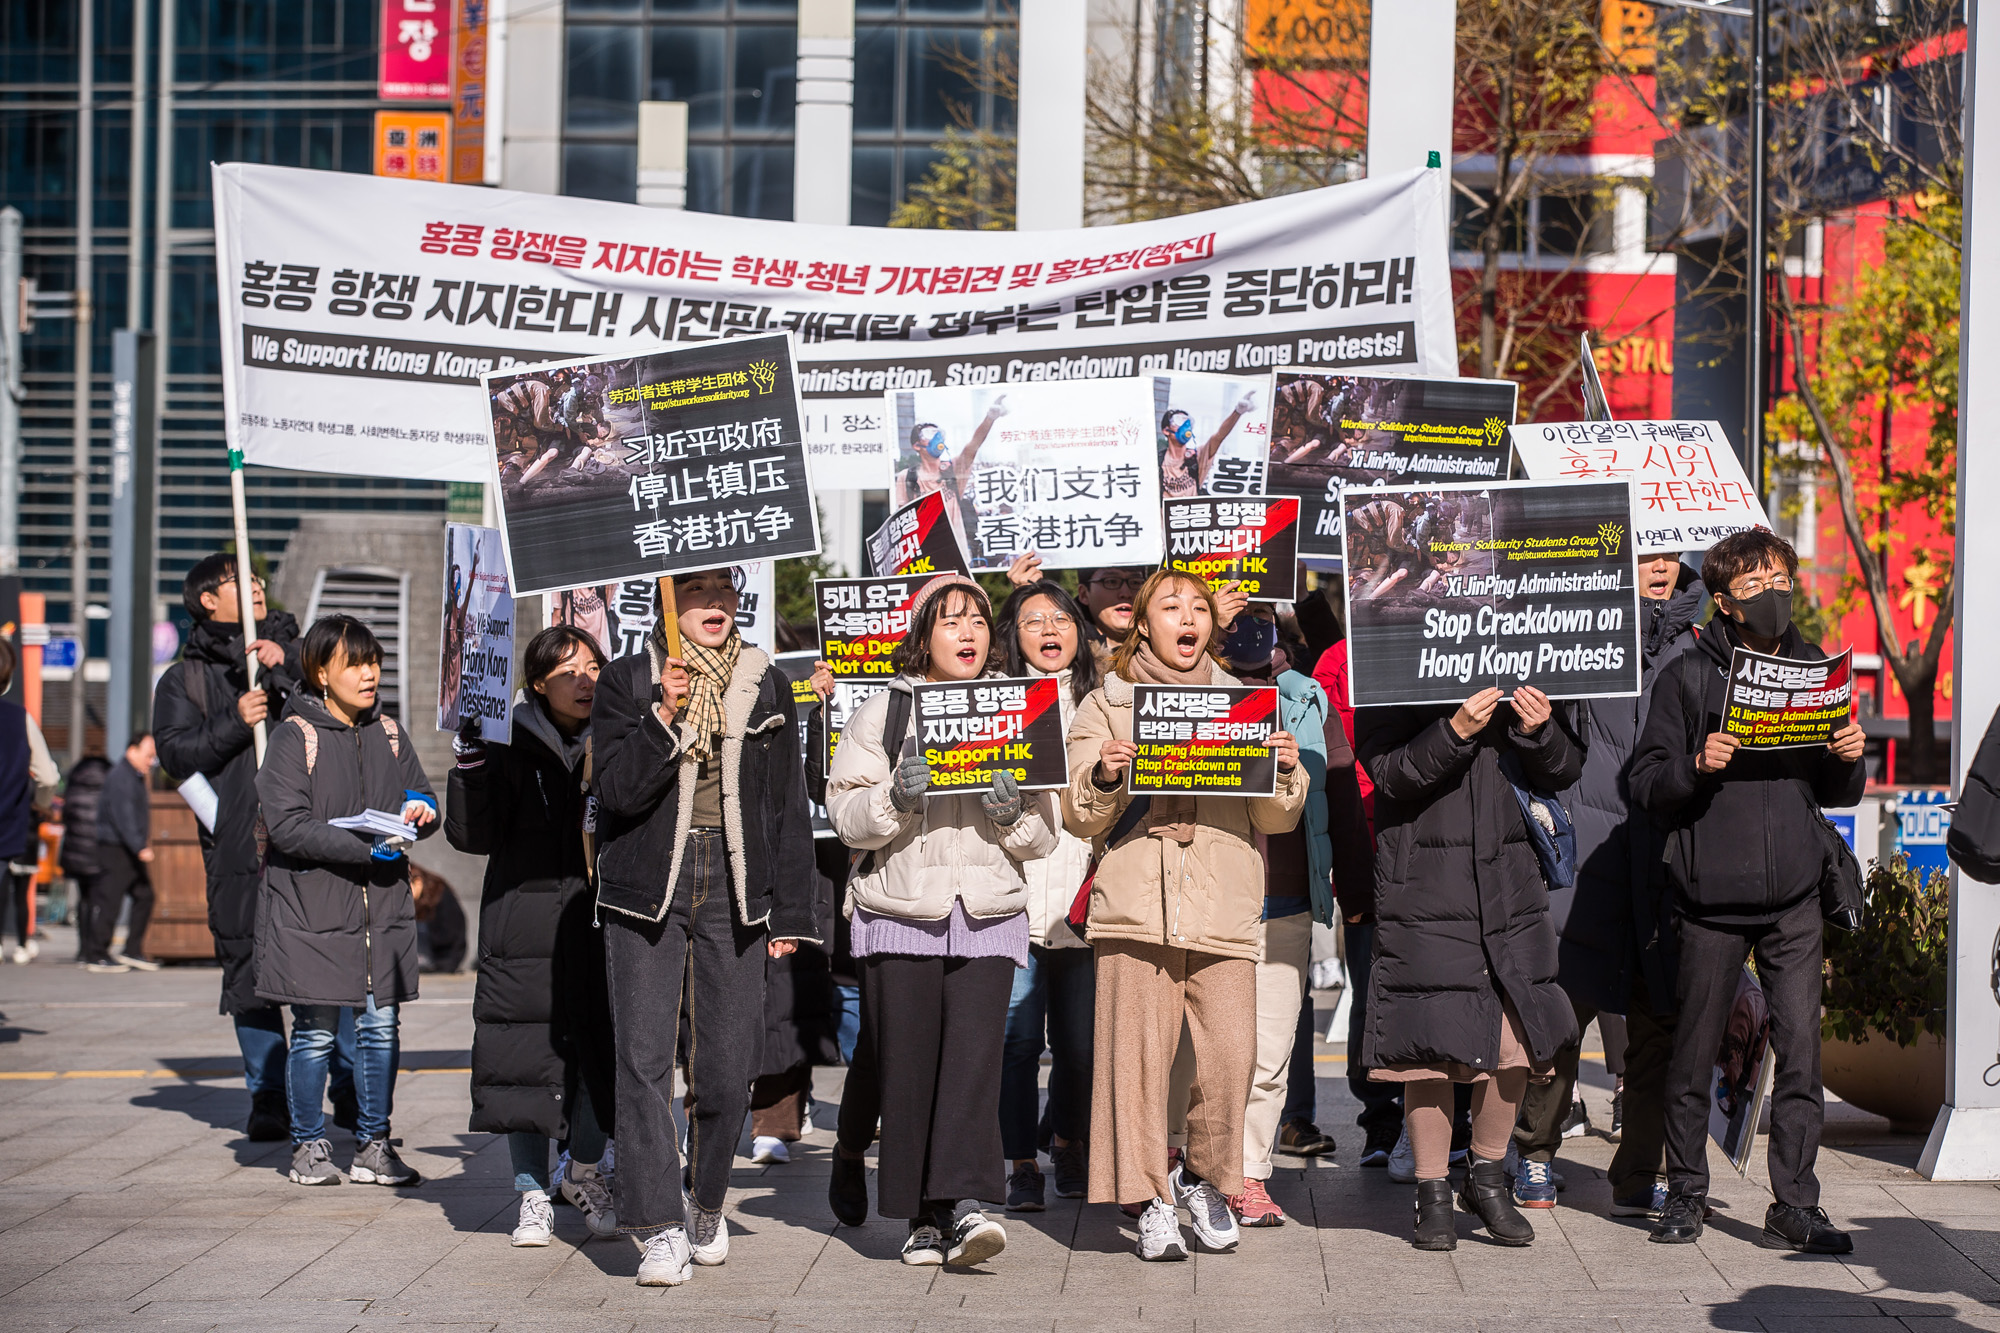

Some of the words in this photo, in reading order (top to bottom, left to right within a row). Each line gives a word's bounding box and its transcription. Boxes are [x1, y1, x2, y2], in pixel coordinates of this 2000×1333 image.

[420, 221, 485, 257] 홍콩
[490, 227, 587, 269] 항쟁을
[592, 241, 722, 281] 지지하는
[875, 265, 1005, 295] 기자회견
[1008, 262, 1043, 290] 및
[1045, 232, 1217, 285] 홍보전(행진)
[242, 260, 320, 311] 홍콩
[328, 268, 420, 320] 항쟁
[424, 279, 623, 337] 지지한다!
[1075, 273, 1211, 329] 탄압을
[1223, 256, 1415, 318] 중단하라!
[251, 333, 279, 362] We
[282, 337, 369, 370] Support
[371, 346, 431, 376] Hong
[432, 350, 493, 379] Kong
[945, 360, 1002, 386] Stop
[1005, 355, 1133, 383] Crackdown
[1139, 353, 1169, 371] on
[1173, 345, 1231, 372] Hong
[1235, 339, 1293, 368] Kong
[1297, 329, 1405, 365] Protests!
[608, 370, 749, 405] 劳动者连带学生团体
[272, 417, 315, 433] 노동자연대
[360, 425, 440, 443] 사회변혁노동자당
[444, 431, 489, 446] 학생위원
[842, 414, 881, 433] 장소:
[1000, 426, 1118, 443] 劳动者连带学生团体
[1341, 419, 1378, 430] Workers'
[1378, 421, 1419, 432] Solidarity
[1419, 423, 1458, 434] Students
[1458, 425, 1484, 437] Group
[1543, 422, 1640, 445] 이한열의
[1641, 422, 1713, 443] 후배들이
[621, 417, 782, 465] 习近平政府
[1350, 450, 1363, 468] Xi
[1363, 451, 1405, 475] JinPing
[1407, 453, 1500, 477] Administration!
[1642, 443, 1719, 478] 시위
[628, 455, 790, 512] 停止镇压
[977, 463, 1142, 504] 我们支持
[1641, 479, 1753, 512] 규탄한다
[889, 507, 920, 544] 항쟁
[1169, 503, 1211, 529] 홍콩
[1216, 502, 1267, 527] 항쟁
[632, 504, 794, 558] 香港抗争
[981, 512, 1143, 552] 香港抗争
[1170, 529, 1262, 555] 지지한다!
[1429, 541, 1473, 553] Workers'
[1475, 539, 1522, 551] Solidarity
[1524, 537, 1568, 548] Students
[1569, 536, 1598, 548] Group
[1172, 557, 1240, 576] Support
[1242, 557, 1268, 574] HK
[823, 585, 860, 609] 5대
[866, 583, 909, 609] 요구
[1446, 576, 1463, 597] Xi
[1463, 574, 1516, 600] JinPing
[1518, 569, 1623, 594] Administration!
[487, 614, 510, 641] Support
[1423, 608, 1472, 644] Stop
[1476, 604, 1593, 637] Crackdown
[1597, 606, 1623, 631] on
[826, 640, 865, 656] Five
[463, 642, 486, 682] Hong
[487, 646, 508, 687] Kong
[830, 659, 860, 674] Not
[863, 660, 895, 673] one
[1418, 648, 1475, 684] Hong
[1478, 645, 1534, 682] Kong
[1536, 641, 1625, 674] Protests
[1736, 658, 1829, 690] 시진핑은
[460, 683, 506, 721] Resistance
[920, 689, 969, 716] 홍콩
[973, 685, 1027, 713] 항쟁
[1138, 692, 1231, 718] 시진핑은
[1733, 684, 1788, 708] 탄압을
[1727, 720, 1753, 736] Stop
[1755, 723, 1815, 734] Crackdown
[1817, 723, 1830, 732] on
[1729, 706, 1740, 718] Xi
[1742, 709, 1779, 724] JinPing
[922, 714, 1024, 744] 지지한다!
[1139, 721, 1193, 740] 탄압을
[1196, 722, 1271, 741] 중단하라!
[1753, 735, 1780, 745] Kong
[1782, 733, 1828, 743] Protests
[925, 747, 1001, 767] Support
[1004, 743, 1033, 761] HK
[1138, 744, 1149, 755] Xi
[1150, 744, 1187, 759] JinPing
[1189, 745, 1269, 757] Administration!
[1136, 759, 1162, 773] Stop
[1164, 759, 1225, 771] Crackdown
[1227, 762, 1241, 771] on
[1135, 774, 1163, 787] Hong
[1165, 774, 1193, 788] Kong
[1194, 774, 1242, 786] Protests
